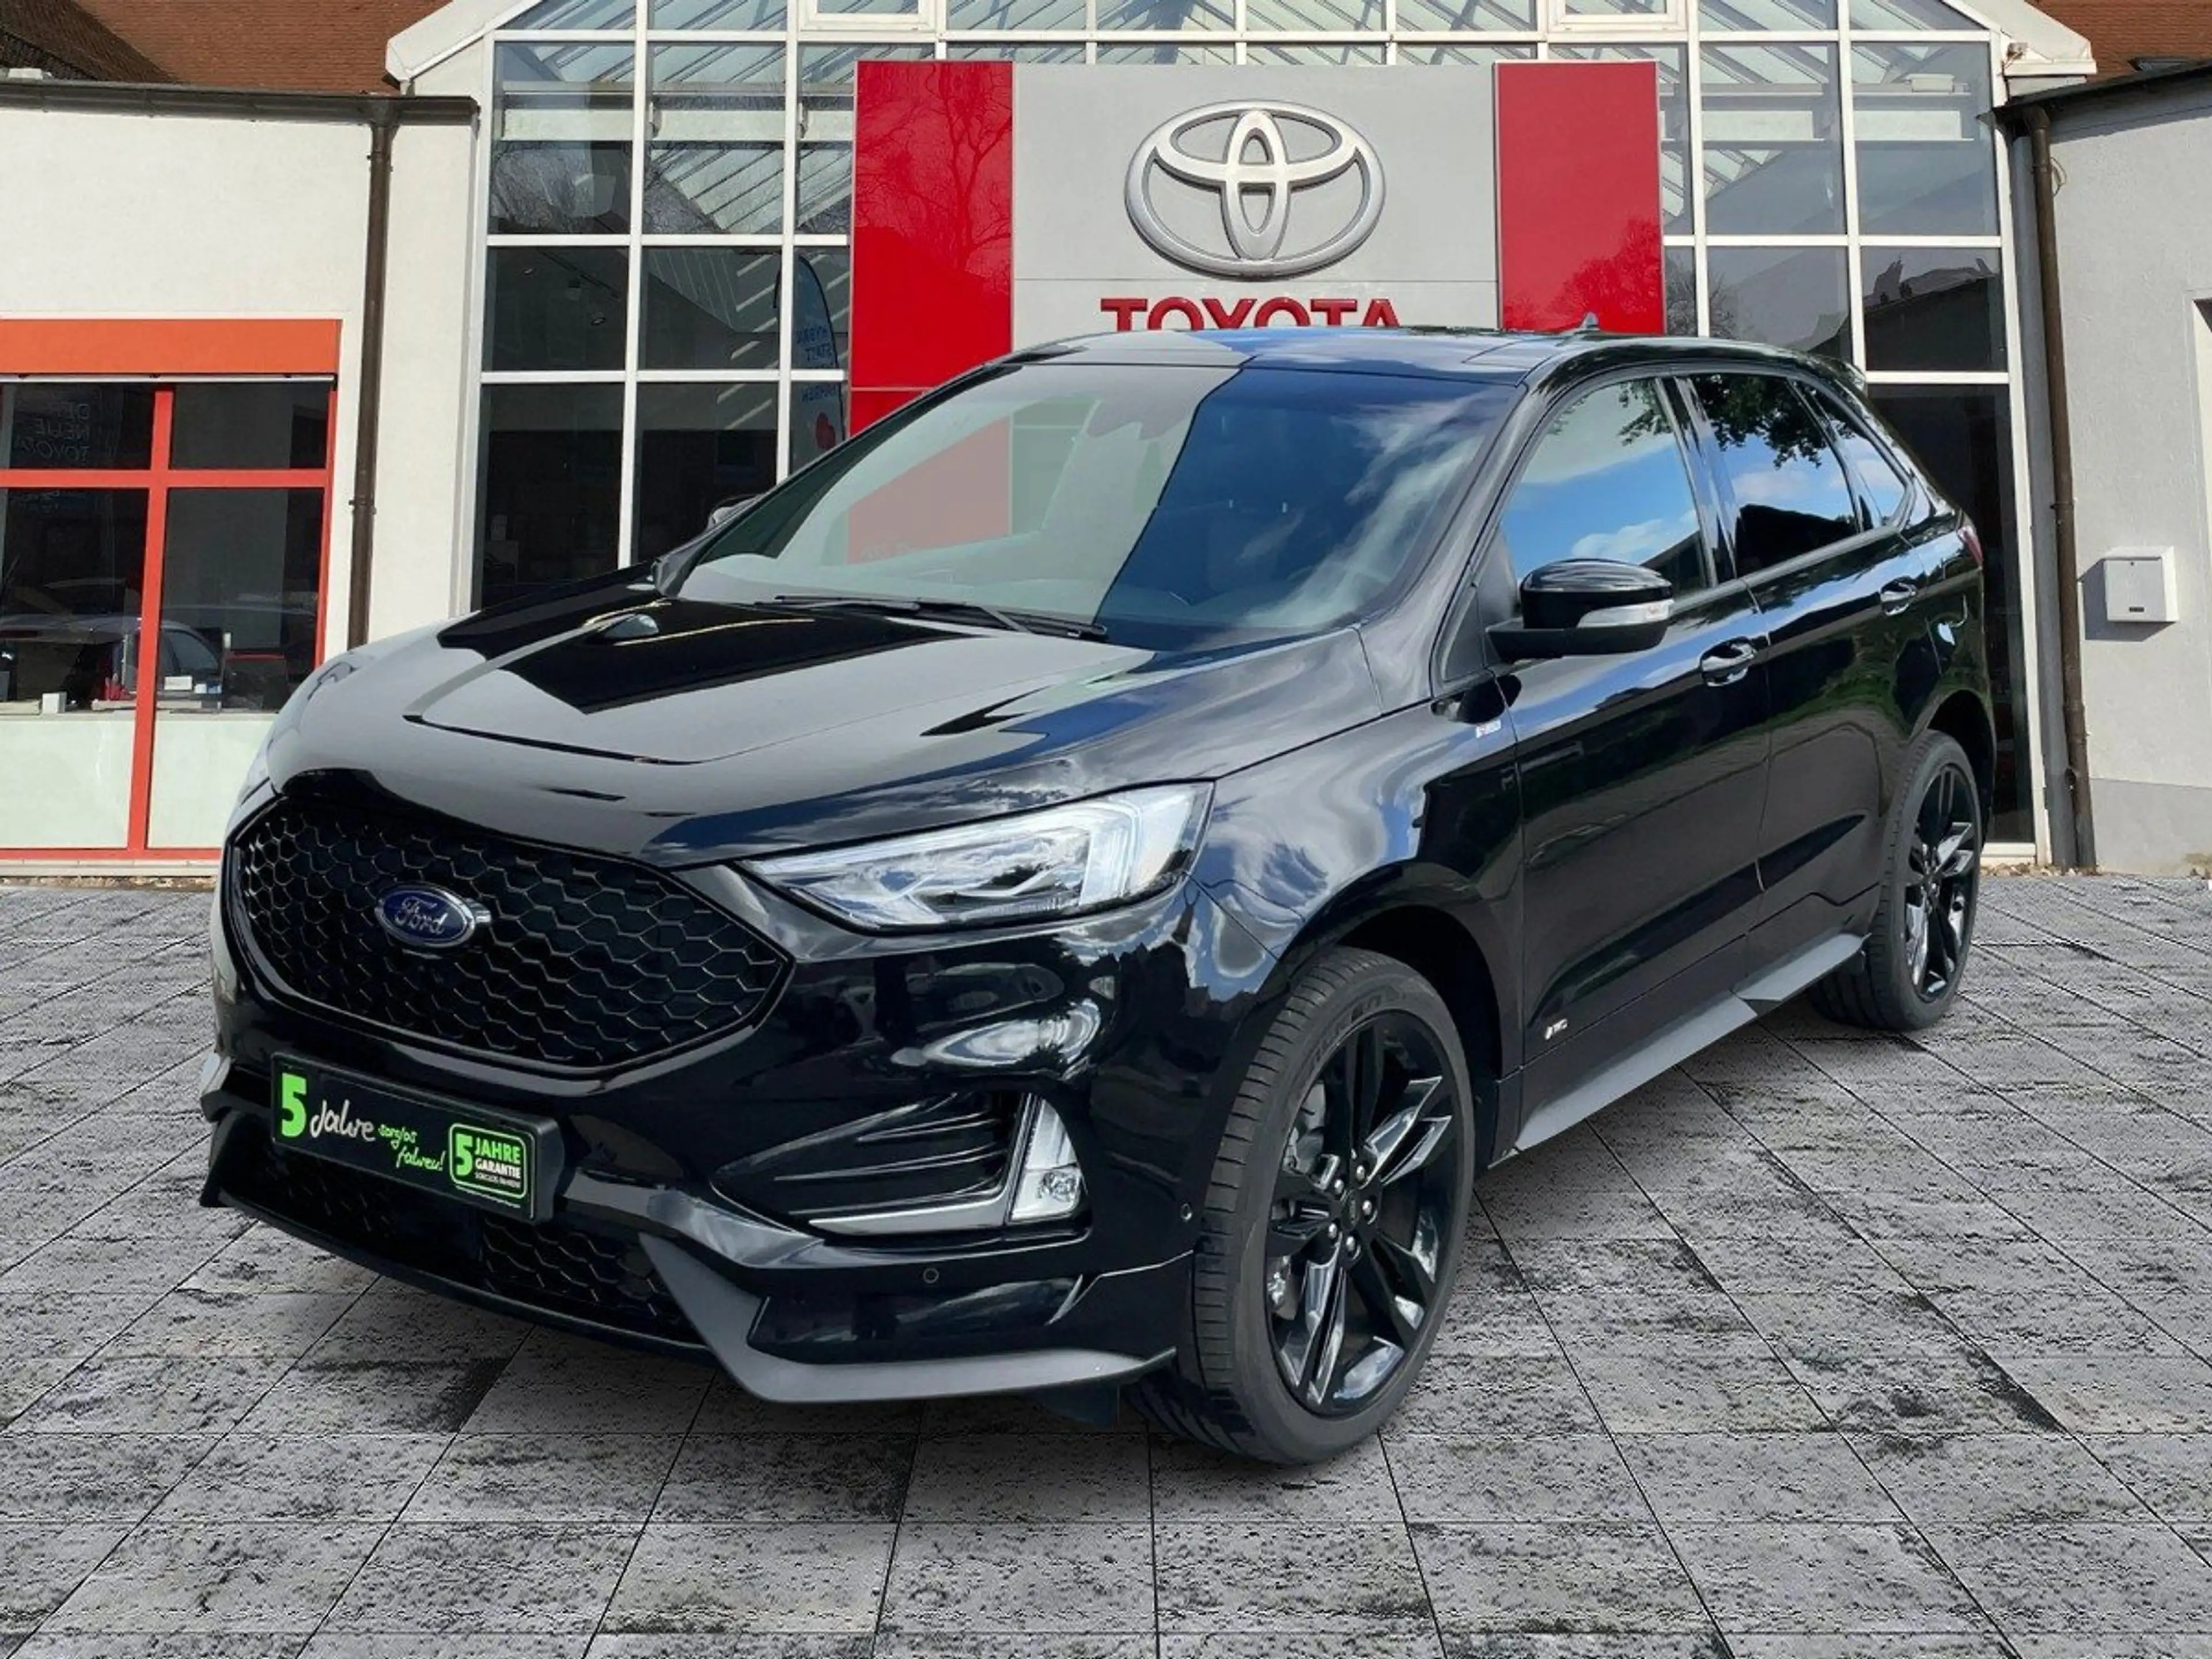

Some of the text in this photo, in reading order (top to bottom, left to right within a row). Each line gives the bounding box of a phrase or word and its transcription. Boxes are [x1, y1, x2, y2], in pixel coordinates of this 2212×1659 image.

[1101, 297, 1400, 331] TOYOTA
[396, 896, 448, 934] Ford
[282, 1073, 376, 1142] 5 Jahre
[377, 1123, 419, 1150] sorglos
[474, 1137, 521, 1164] JAHRE
[456, 1133, 472, 1176] 5
[475, 1157, 521, 1179] GARANTIE
